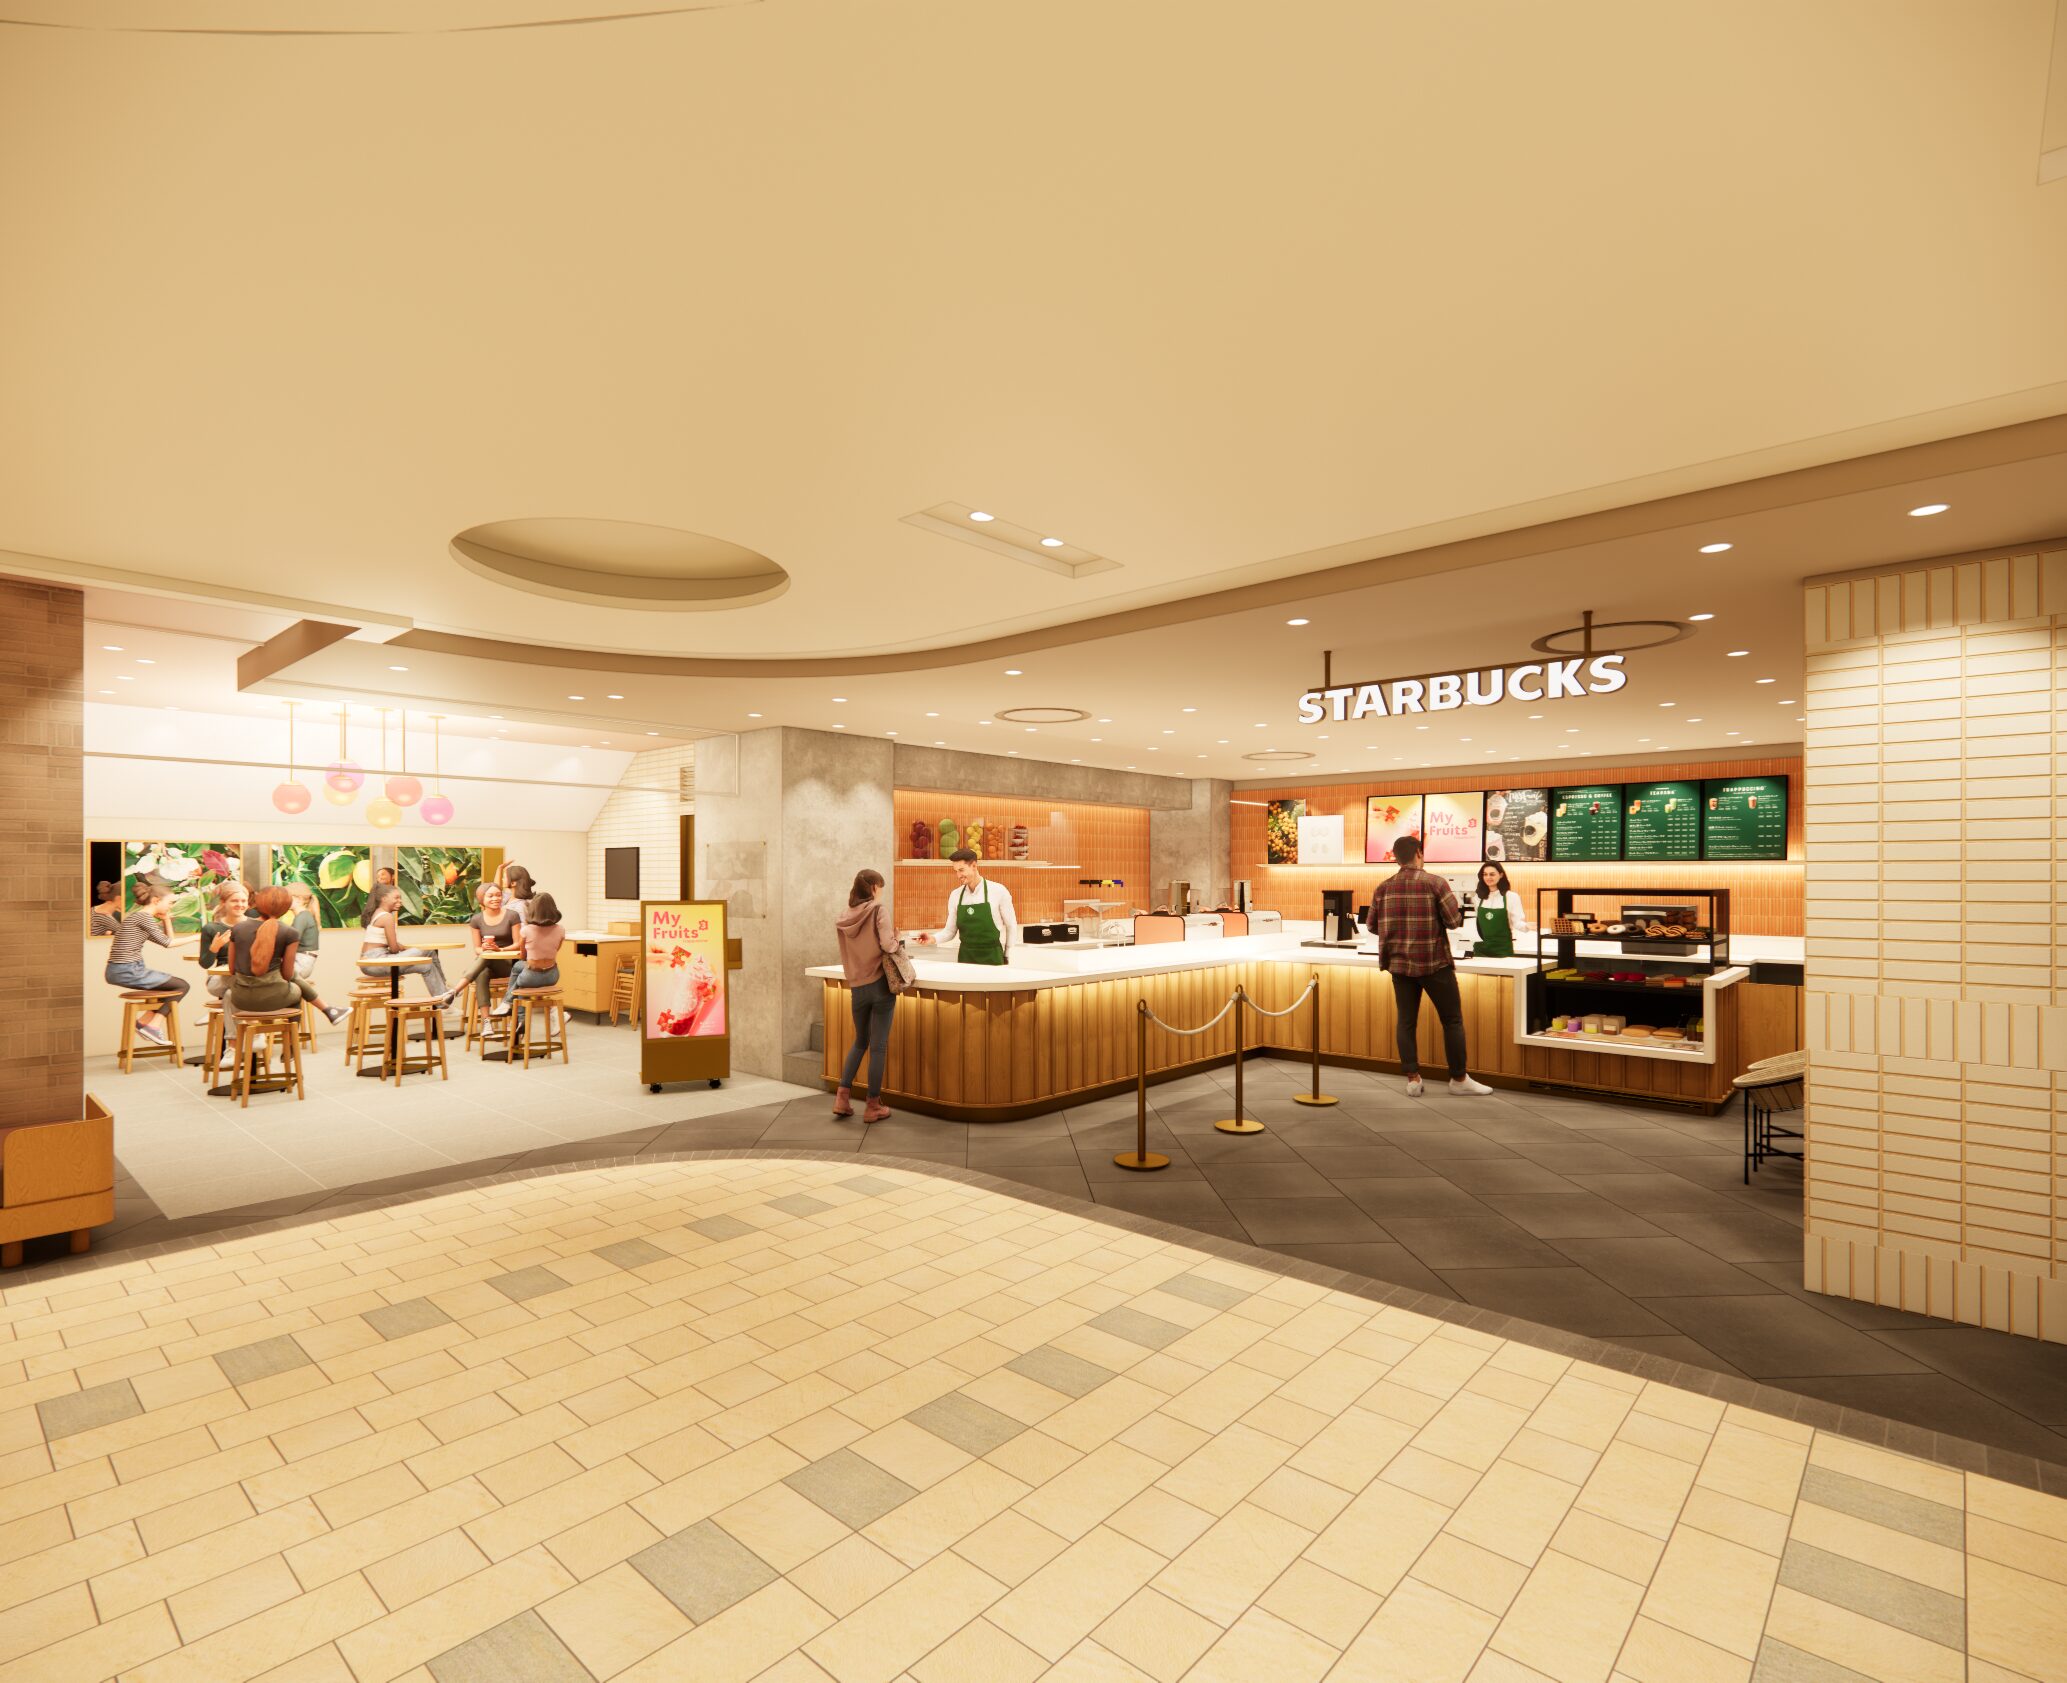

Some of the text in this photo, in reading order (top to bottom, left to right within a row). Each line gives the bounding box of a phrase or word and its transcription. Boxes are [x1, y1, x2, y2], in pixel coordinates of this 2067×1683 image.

[1297, 654, 1627, 724] STARBUCKS
[1429, 811, 1454, 826] My
[1429, 823, 1468, 836] Fruits
[653, 911, 681, 928] My
[653, 925, 699, 939] Fruits
